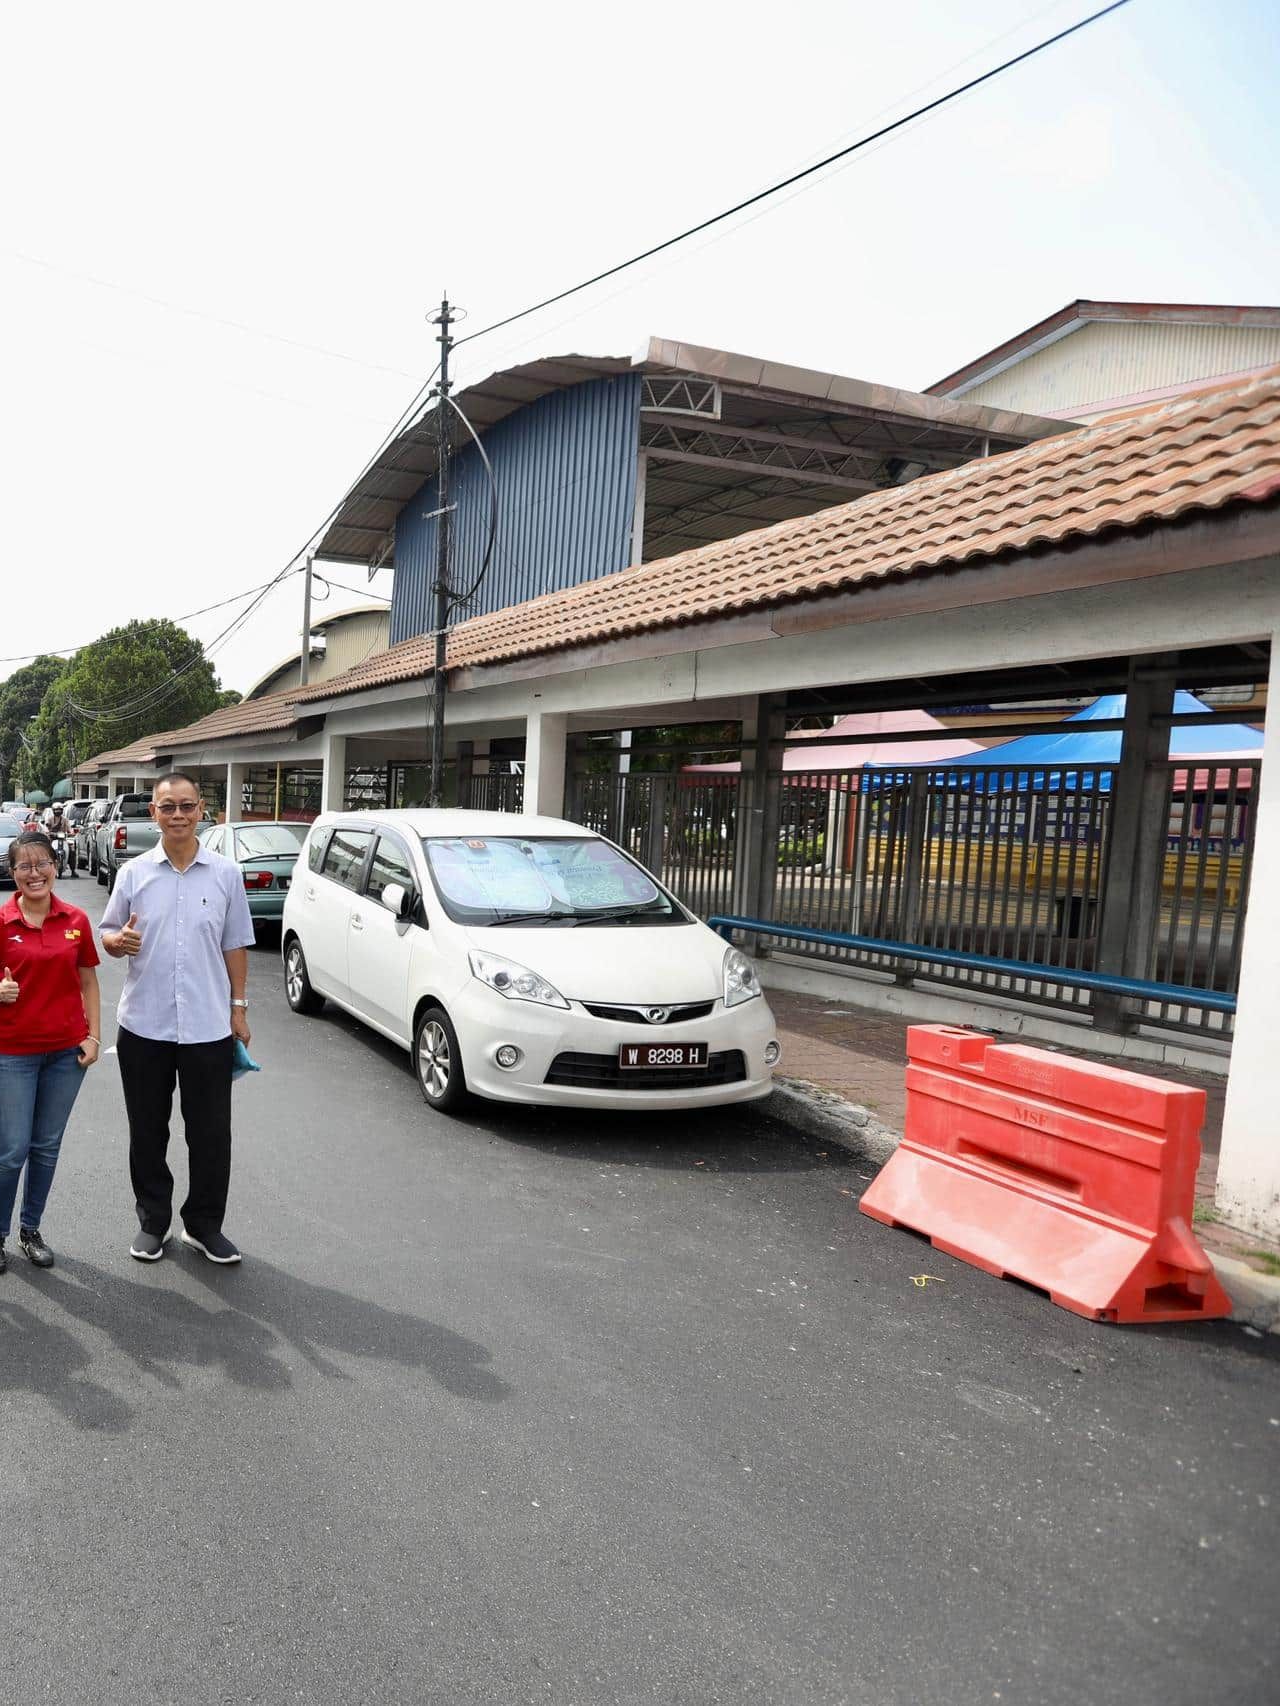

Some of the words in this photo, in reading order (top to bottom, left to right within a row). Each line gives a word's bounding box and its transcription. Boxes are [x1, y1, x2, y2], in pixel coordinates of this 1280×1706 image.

[628, 1048, 639, 1065] W
[648, 1048, 684, 1064] 8298
[689, 1047, 699, 1064] H
